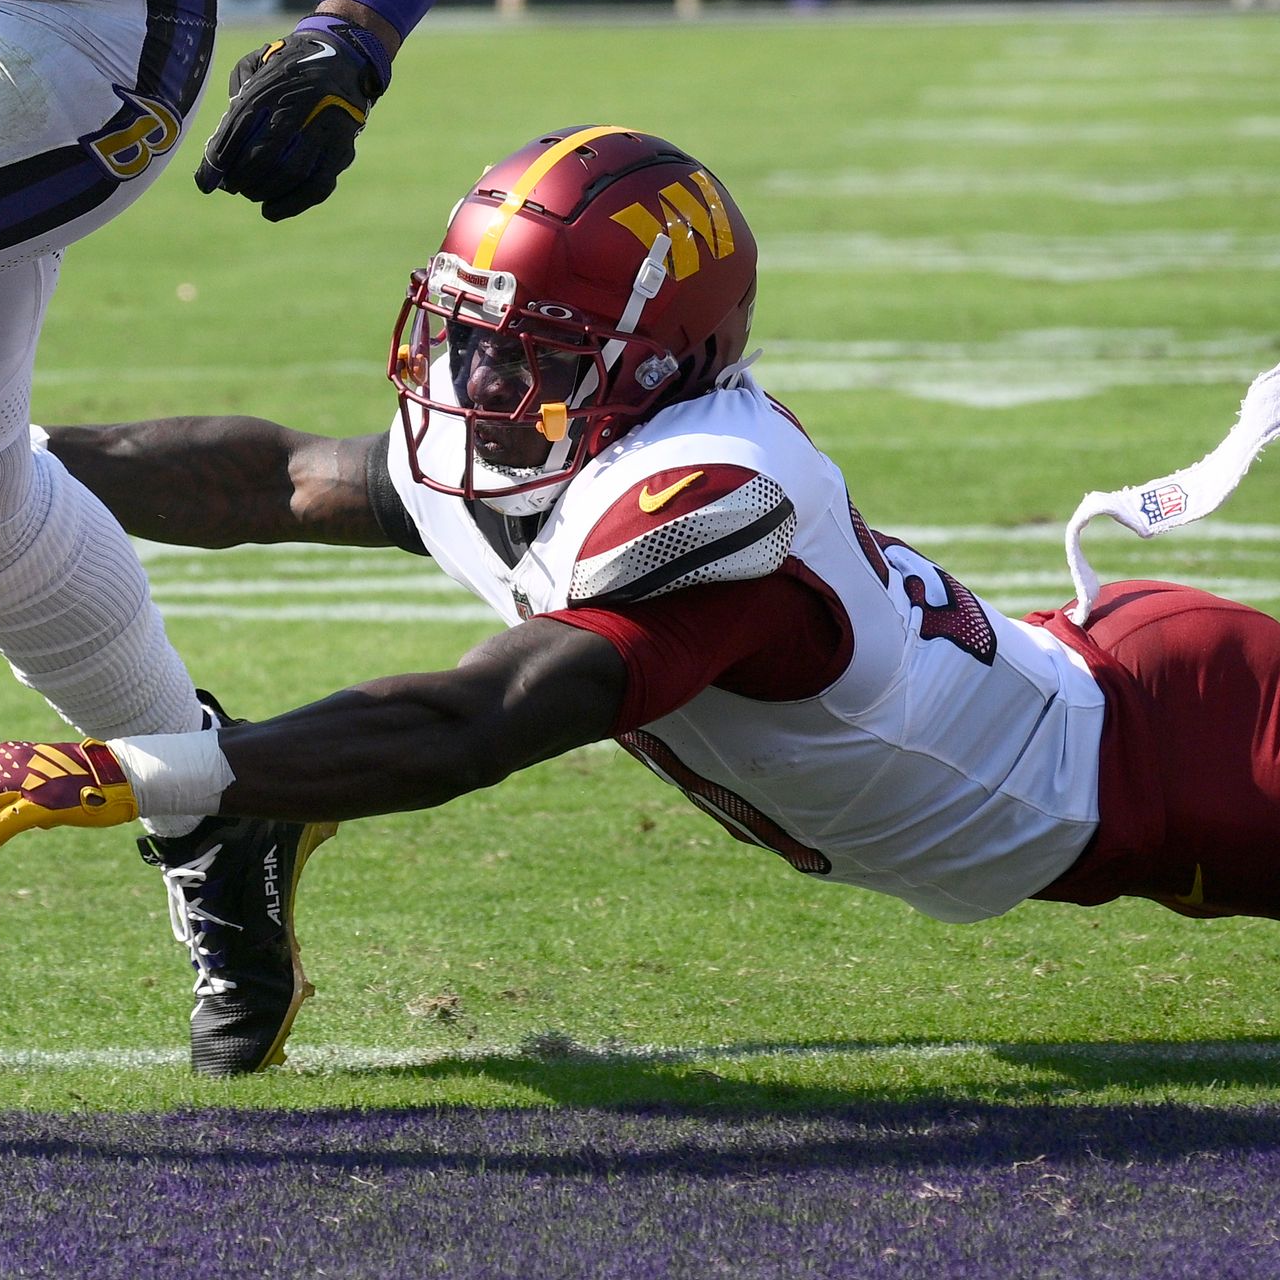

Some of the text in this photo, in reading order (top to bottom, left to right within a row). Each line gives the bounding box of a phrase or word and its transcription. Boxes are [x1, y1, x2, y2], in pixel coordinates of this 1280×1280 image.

[83, 86, 182, 180] B
[1159, 486, 1183, 516] NFL
[263, 844, 282, 927] ALPHA
